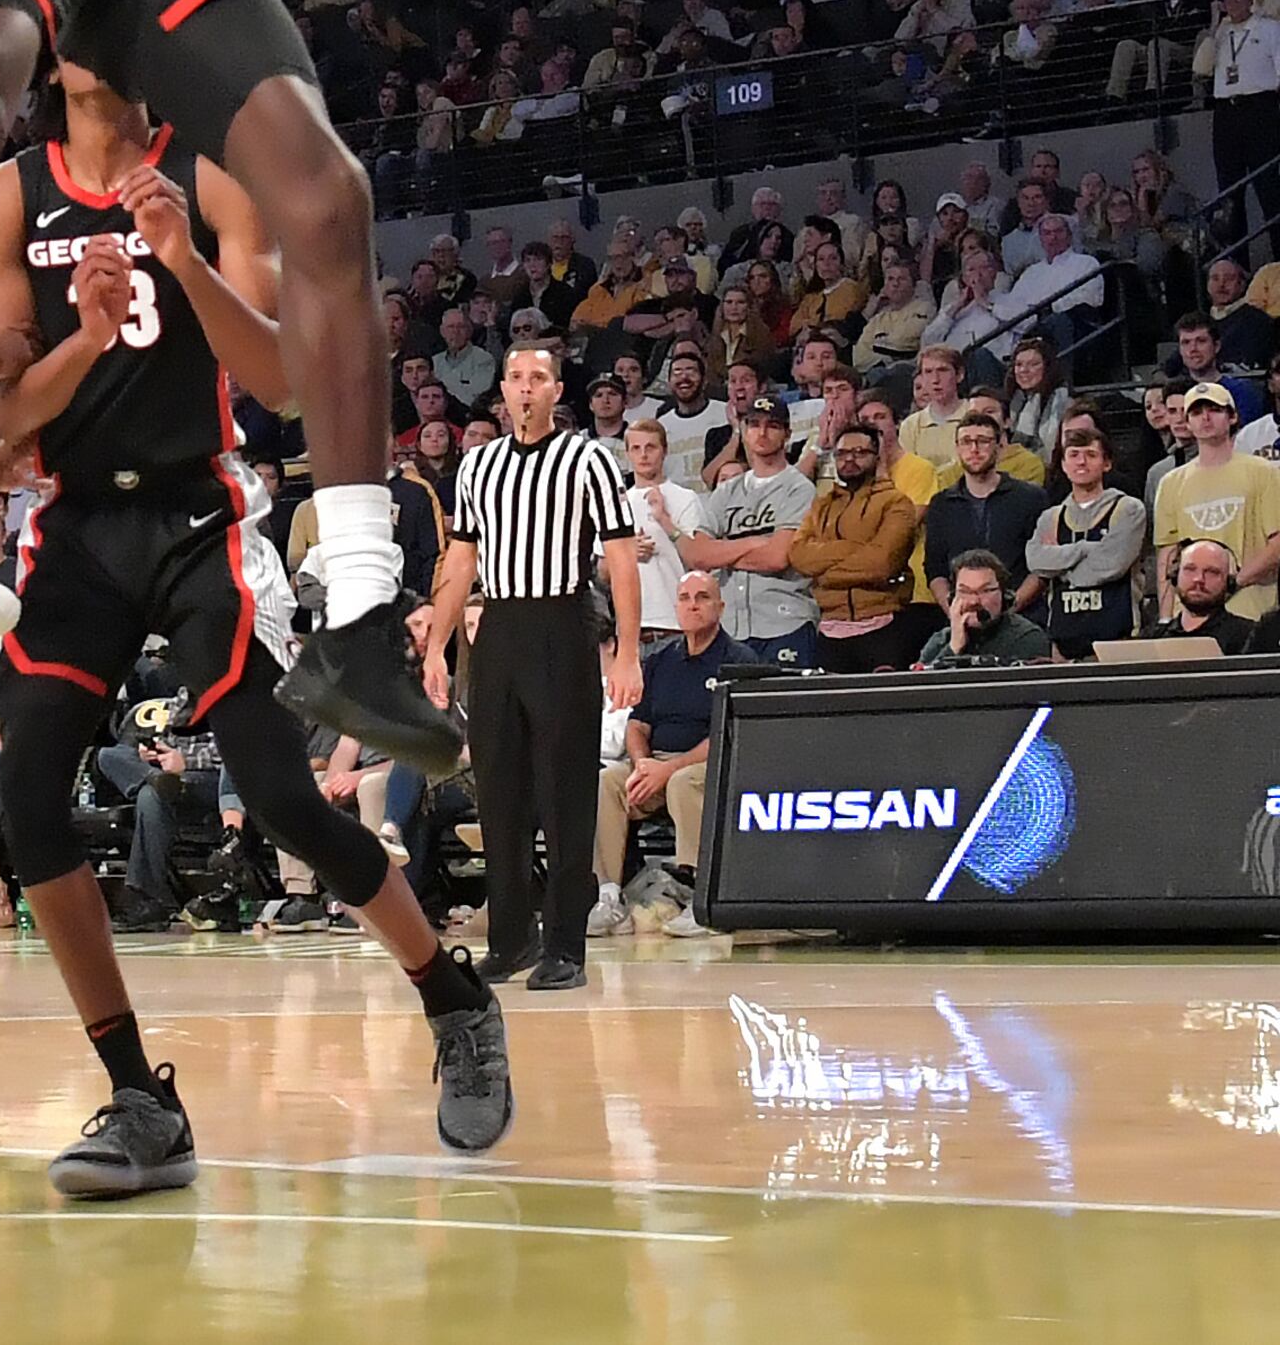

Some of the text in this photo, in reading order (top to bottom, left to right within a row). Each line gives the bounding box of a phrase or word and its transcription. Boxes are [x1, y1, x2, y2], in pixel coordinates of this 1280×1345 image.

[727, 82, 762, 106] 109
[68, 269, 162, 348] 3
[1061, 590, 1104, 614] TECH
[739, 788, 957, 833] NISSAN
